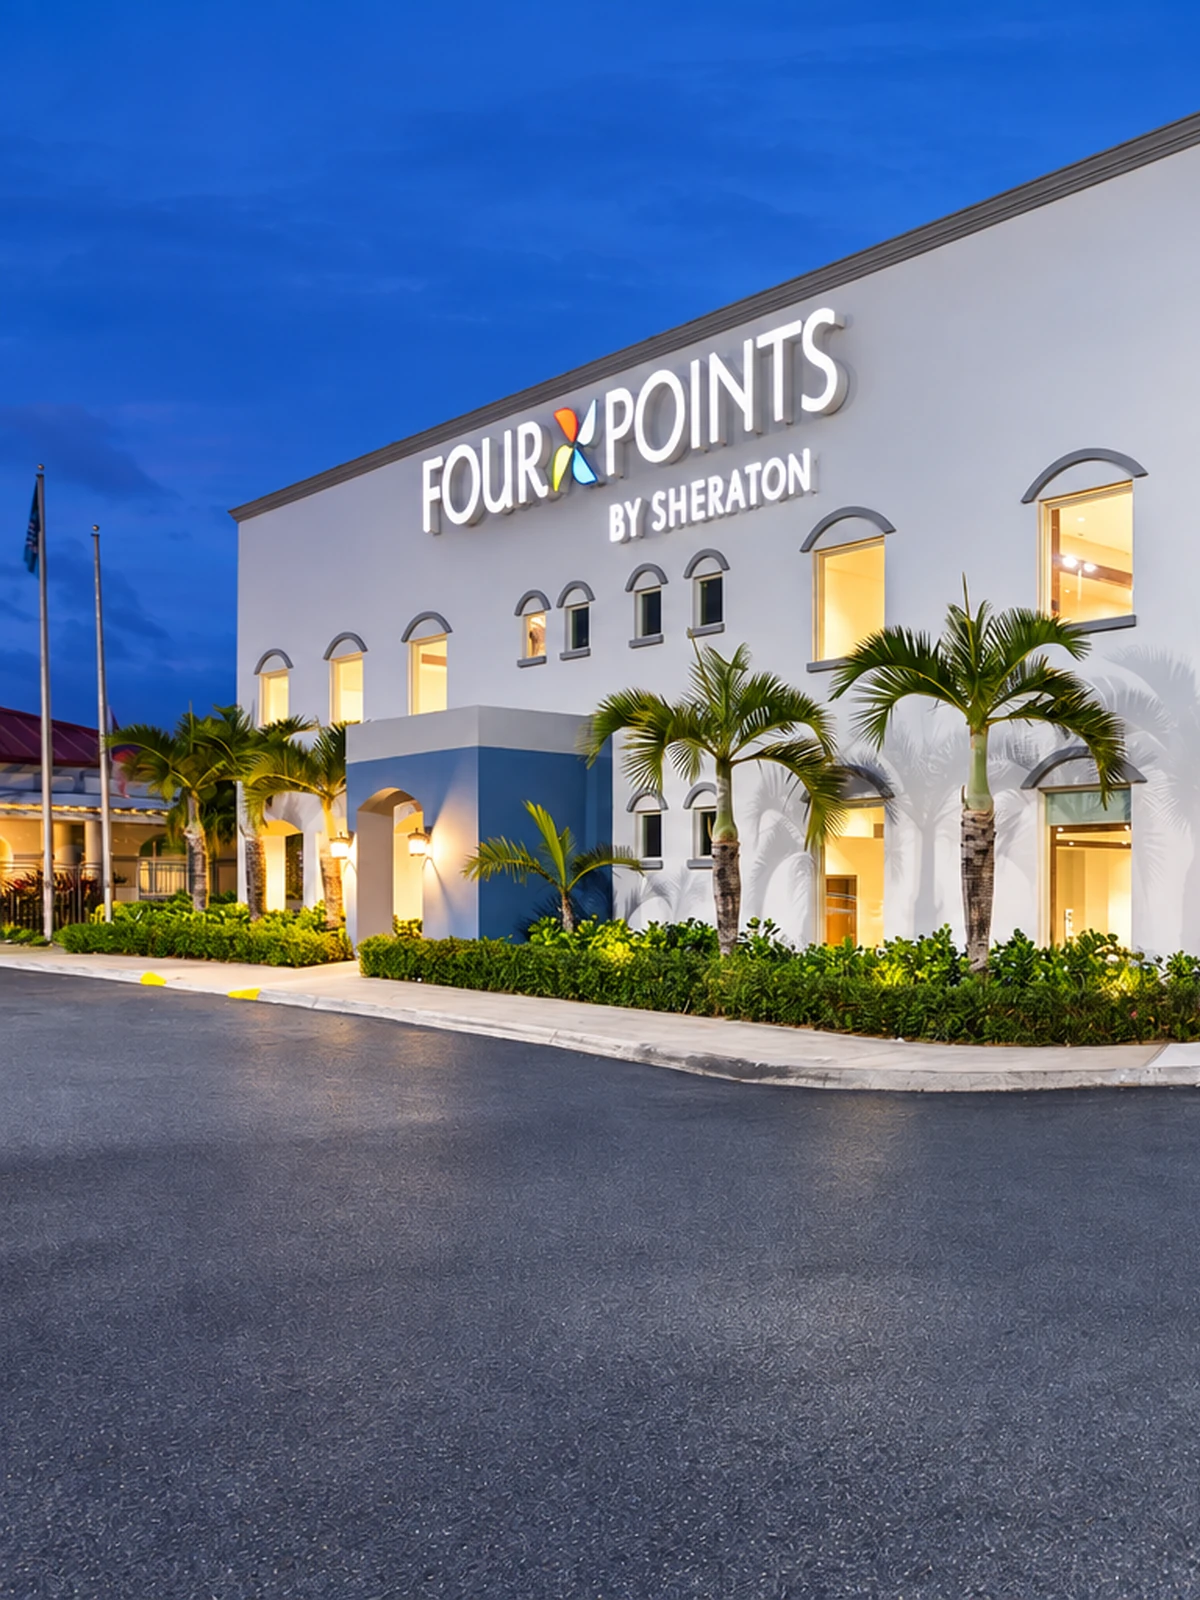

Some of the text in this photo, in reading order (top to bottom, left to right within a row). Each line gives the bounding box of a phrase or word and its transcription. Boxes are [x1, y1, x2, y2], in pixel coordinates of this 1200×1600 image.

[422, 307, 838, 534] FOUR POINTS
[609, 448, 812, 543] BY SHERATON
